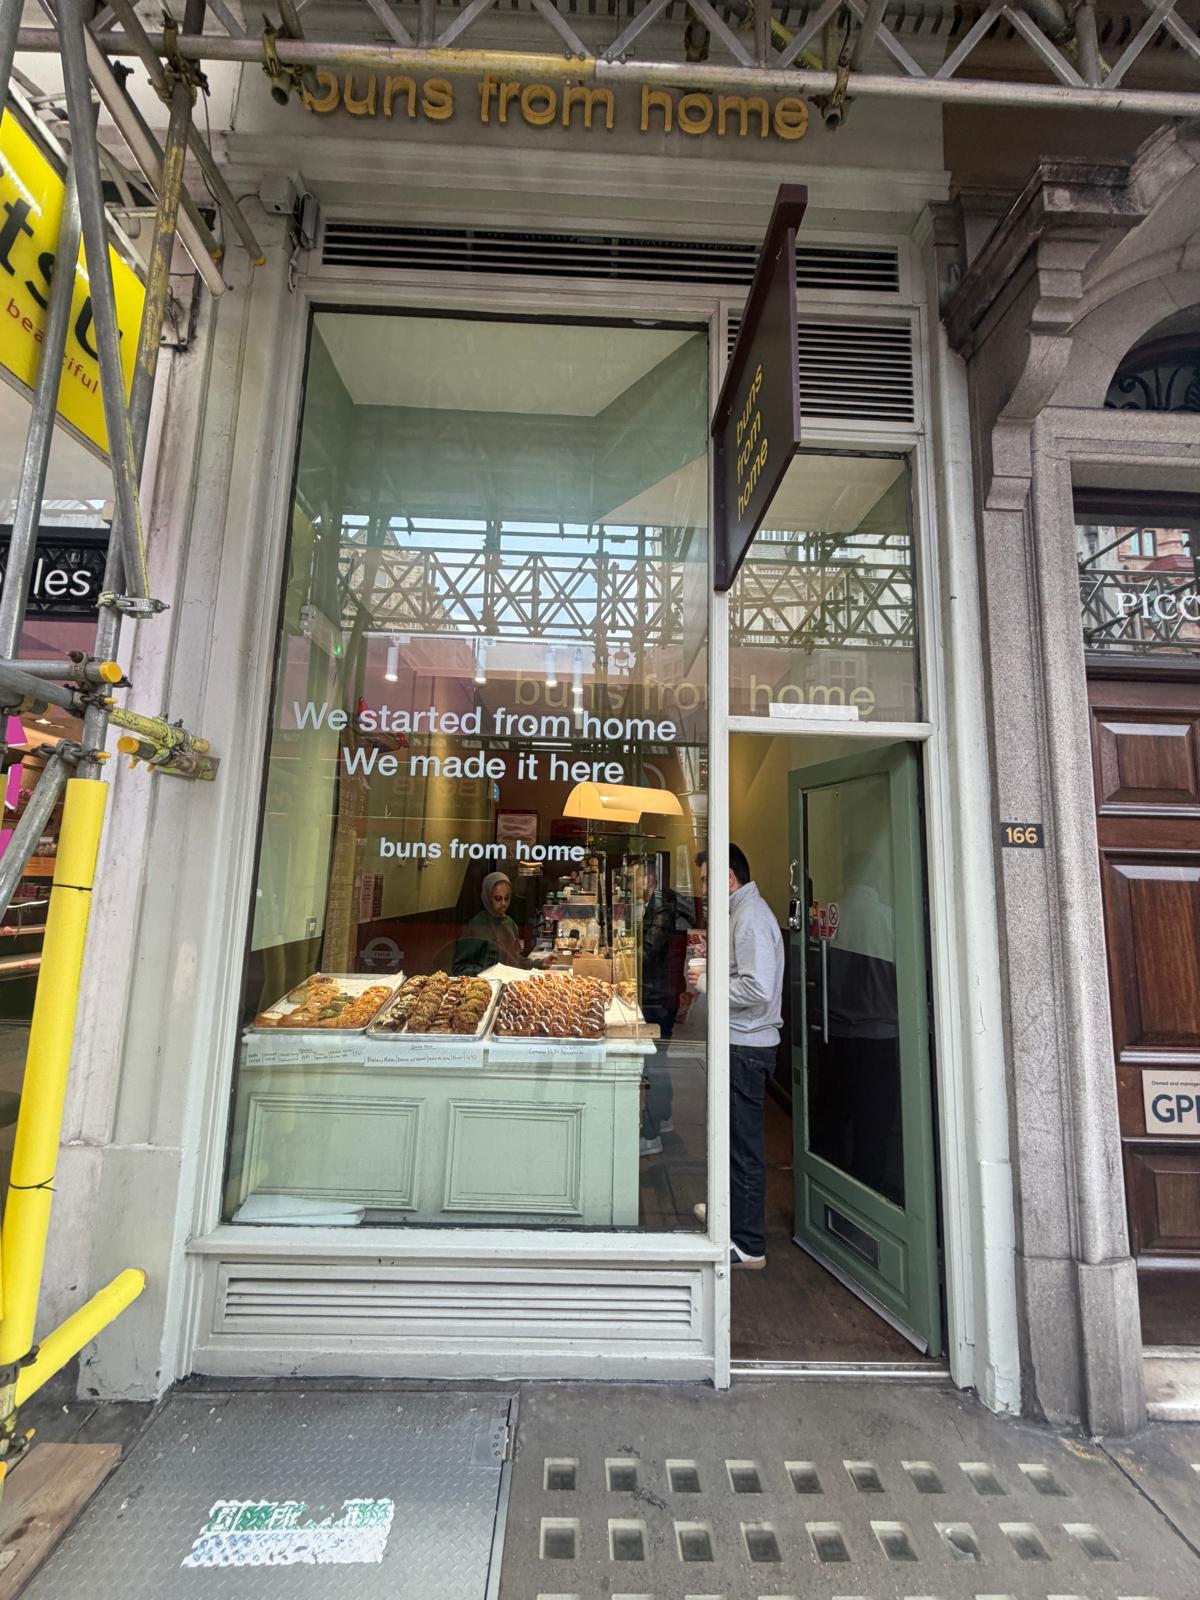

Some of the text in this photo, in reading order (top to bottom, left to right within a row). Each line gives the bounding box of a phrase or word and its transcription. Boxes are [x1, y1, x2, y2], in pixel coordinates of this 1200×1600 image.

[641, 83, 809, 139] home
[736, 364, 763, 449] buns
[736, 410, 761, 485] from
[737, 437, 769, 523] home
[750, 674, 876, 716] home
[292, 701, 677, 742] We started from home
[342, 747, 625, 784] We made it here
[379, 836, 586, 862] buns from home
[1006, 826, 1039, 844] 166
